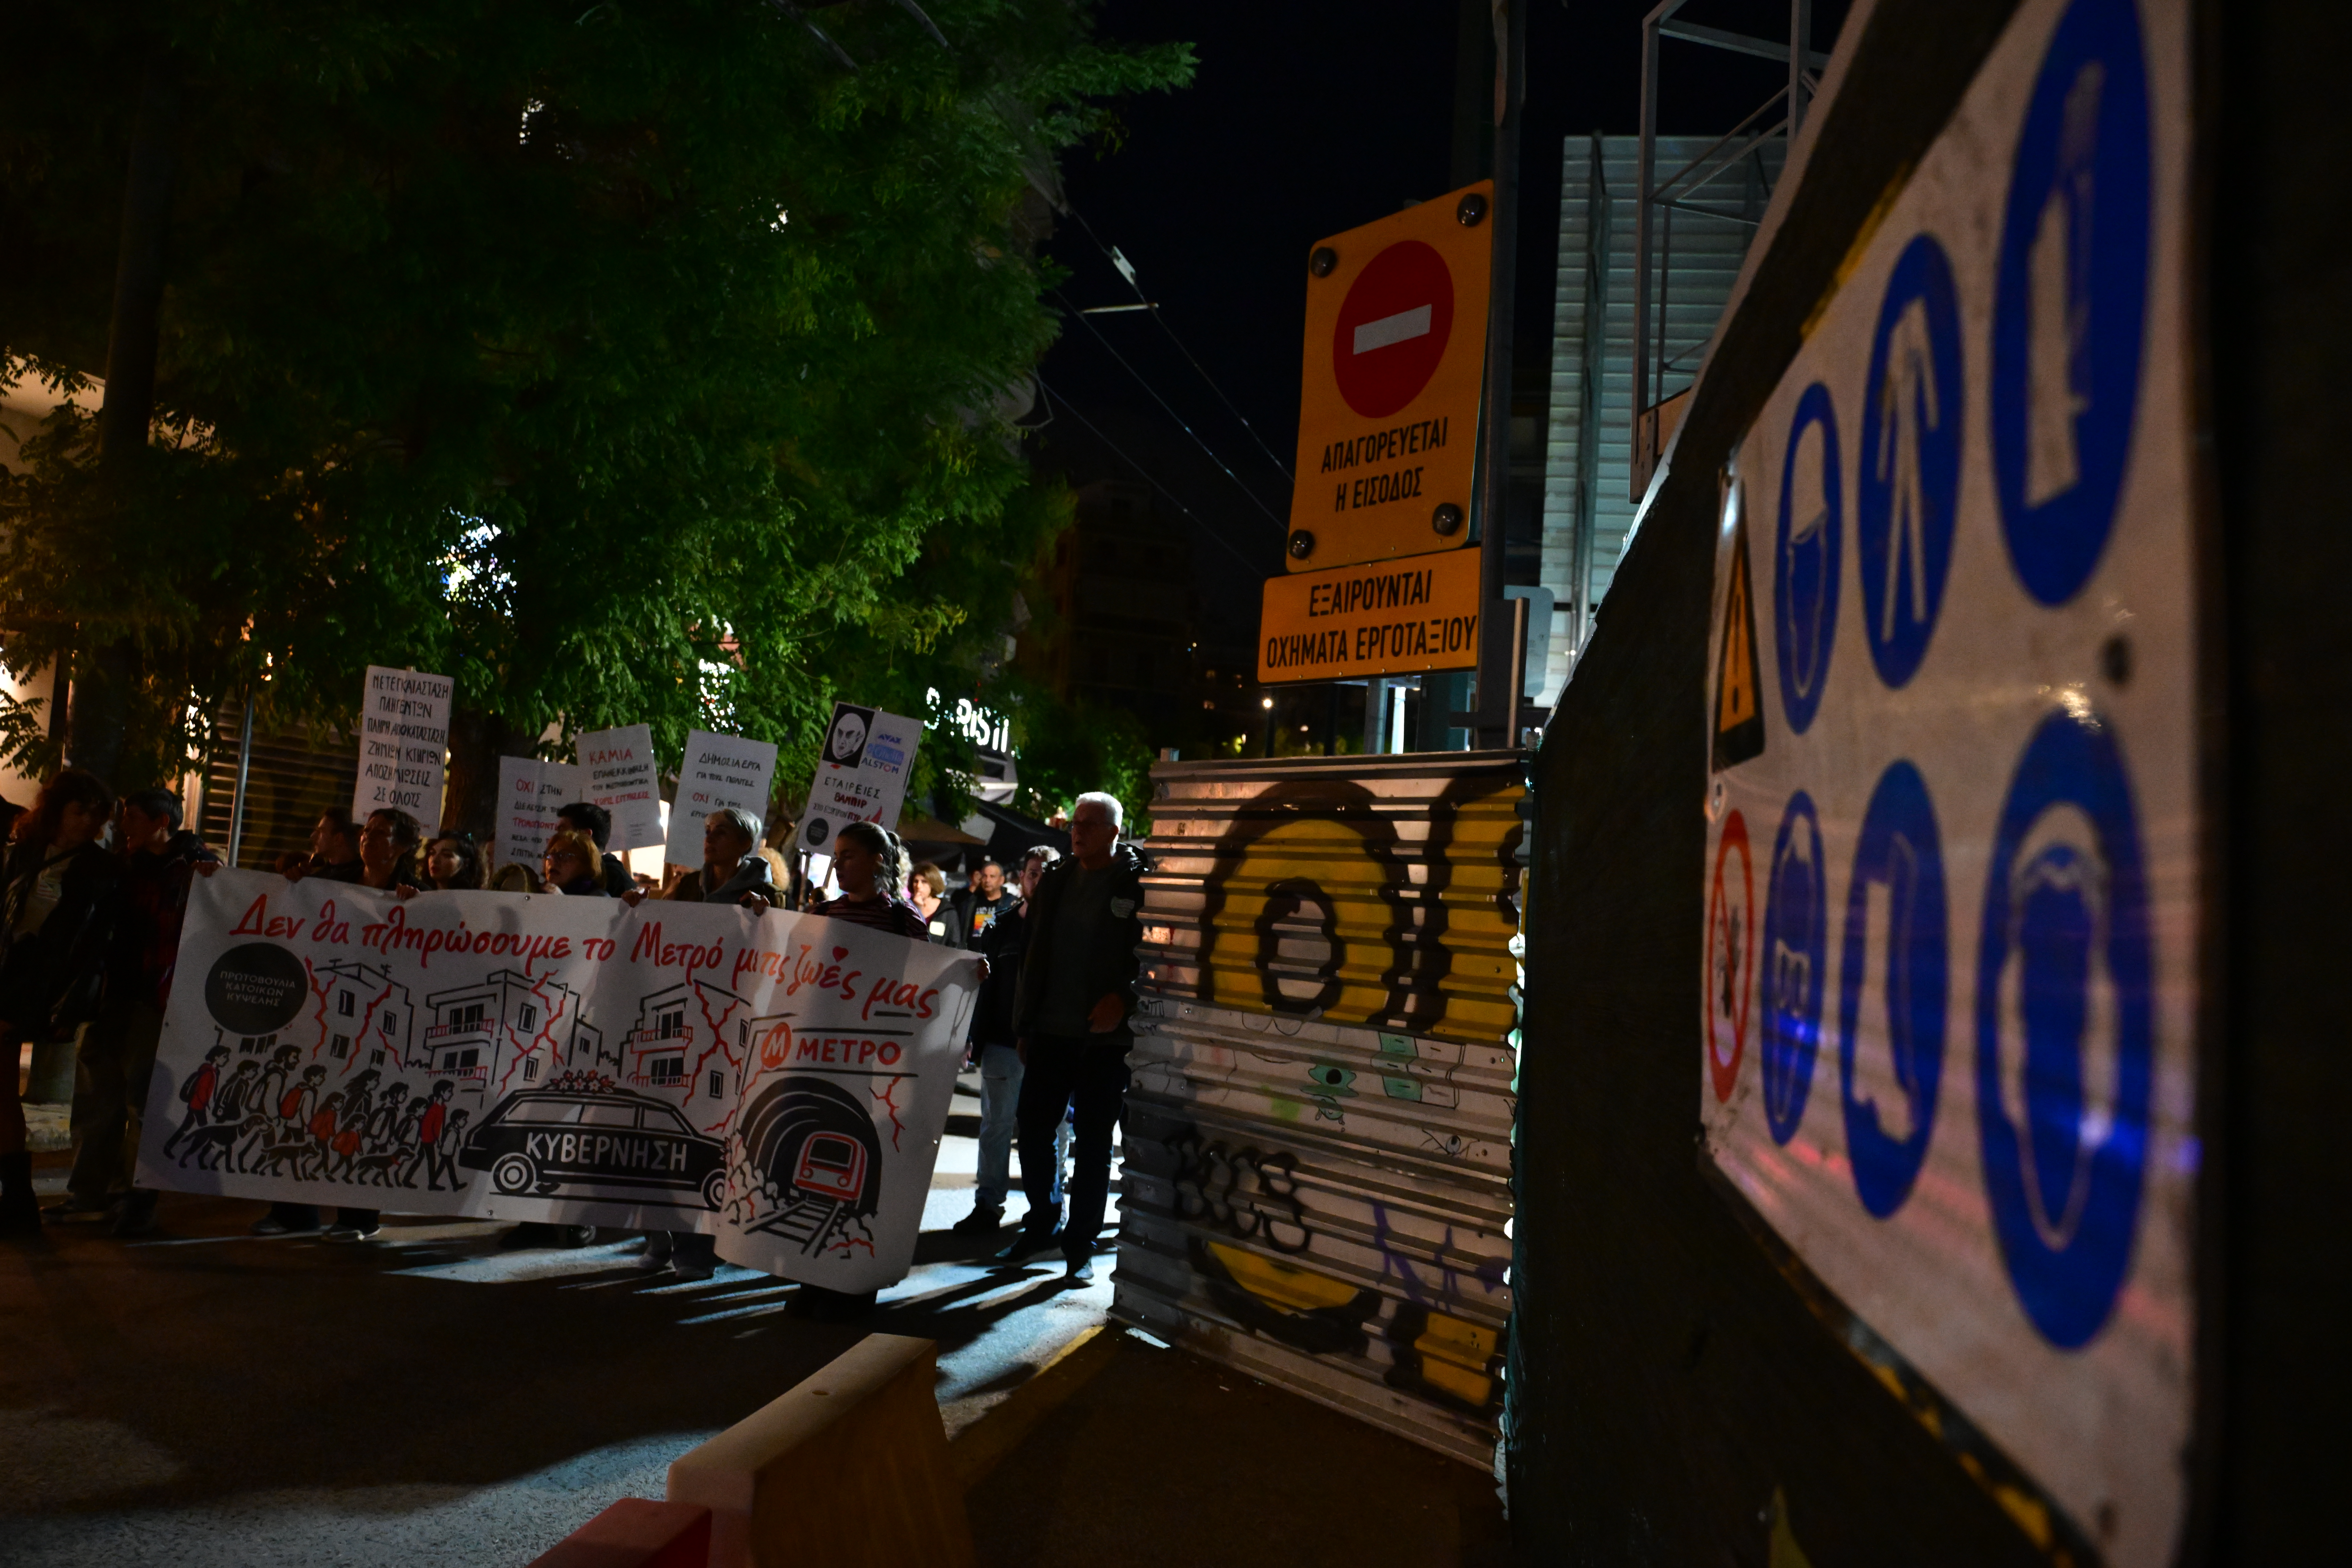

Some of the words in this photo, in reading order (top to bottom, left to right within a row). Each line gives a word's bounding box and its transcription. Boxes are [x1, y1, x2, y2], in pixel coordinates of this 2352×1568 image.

[1321, 417, 1448, 473] ΑΠΑΓΟΡΕΥΕΤΑΙ
[1336, 483, 1347, 512] Η
[1353, 467, 1424, 509] ΕΙΣΟΔΟΣ
[1309, 570, 1432, 616] ΕΞΑΙΡΟΥΝΤΑΙ
[1267, 630, 1348, 668] ΟΧΗΜΑΤΑ
[1356, 615, 1477, 661] ΕΡΓΟΤΑΞΙΟΥ
[373, 676, 449, 699] ΜΕΤΕΓΚΑΤΑΣΤΑΣΗ
[380, 696, 432, 718] ΠΛΗΓΕΝΤΩΝ
[367, 718, 390, 735] ΠΛΗΡΗ
[391, 724, 445, 745] ΑΠΟΚΑΤΑΣΤΑΣΗ
[368, 740, 401, 760] ΖΗΜΙΩΝ
[589, 748, 633, 765] ΚΑΜΙΑ
[699, 752, 740, 768] ΔΗΜΟΣΙΑ
[742, 760, 760, 771] ΕΡΓΑ
[861, 757, 899, 774] ALSTOM
[373, 786, 386, 802] ΣΕ
[390, 790, 422, 808] ΟΛΟΥΣ
[516, 778, 534, 792] ΟΧΙ
[539, 784, 562, 795] ΣΤΗΝ
[824, 776, 881, 799] ΕΤΑΙΡΕΙΕΣ
[834, 792, 867, 808] ΒΑΜΠΙΡ
[229, 894, 305, 938] Δεν
[312, 899, 349, 944] θα
[362, 906, 572, 976] πληρώσουμε
[583, 938, 615, 961] το
[630, 922, 724, 985] Μετρό
[862, 977, 938, 1021] μας
[220, 971, 296, 988] ΠΡΩΤΟΒΟΥΛΙΑ
[226, 982, 284, 997] ΚΑΤΟΙΚΩΝ
[227, 993, 280, 1007] ΚΥΨΕΛΗΣ
[797, 1038, 901, 1064] ΜΕΤΡΟ
[525, 1132, 687, 1171] ΚΥΒΕΡΝΗΣΗ
